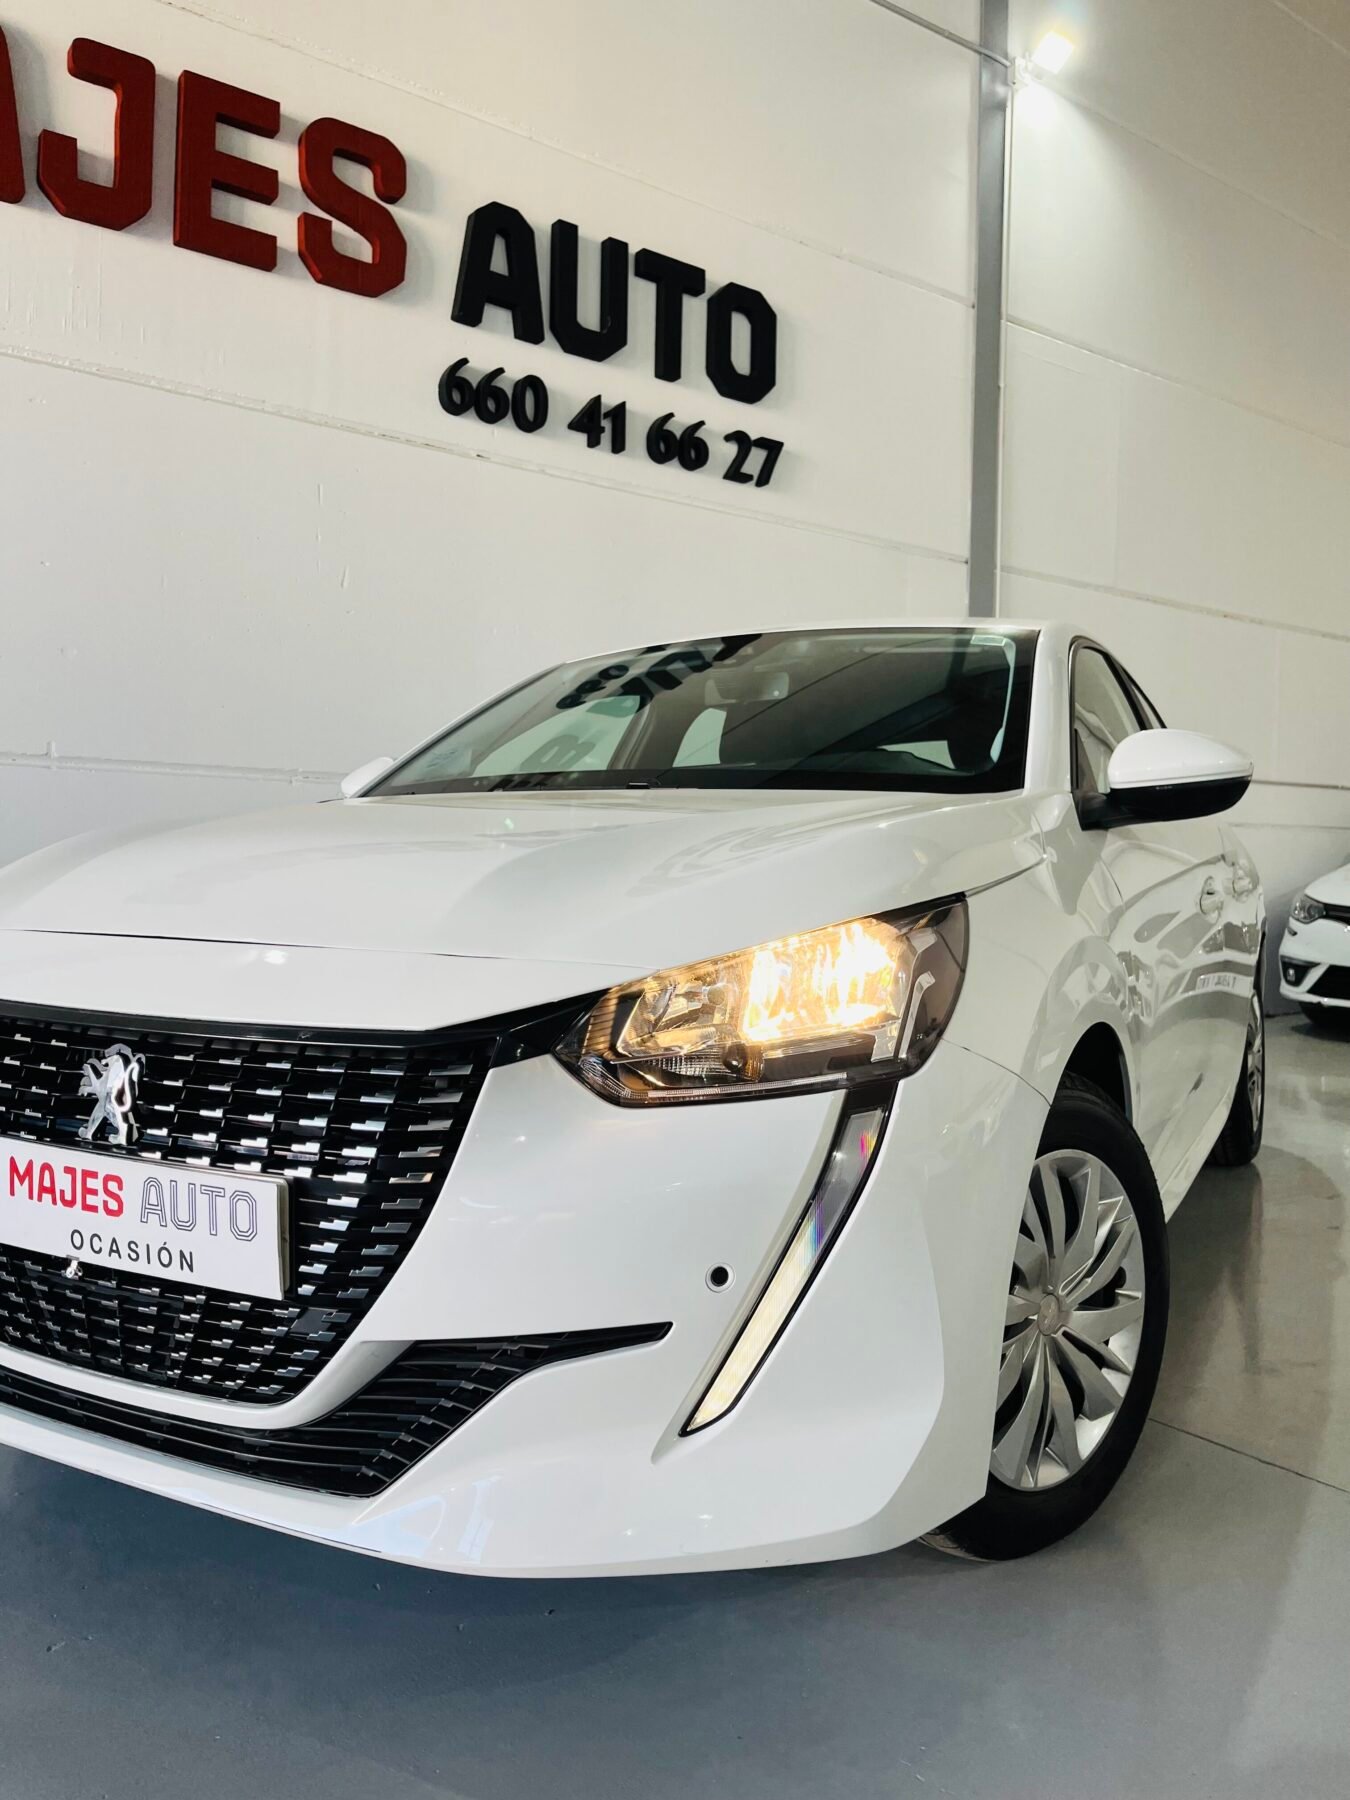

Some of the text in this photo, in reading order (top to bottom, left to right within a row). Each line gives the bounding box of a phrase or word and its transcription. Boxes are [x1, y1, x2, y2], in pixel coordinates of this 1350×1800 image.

[0, 24, 778, 405] JES AUTO
[438, 357, 785, 488] 660 41 66 27
[9, 1156, 258, 1243] MAJES AUTO
[70, 1228, 194, 1273] OCASIÓN
